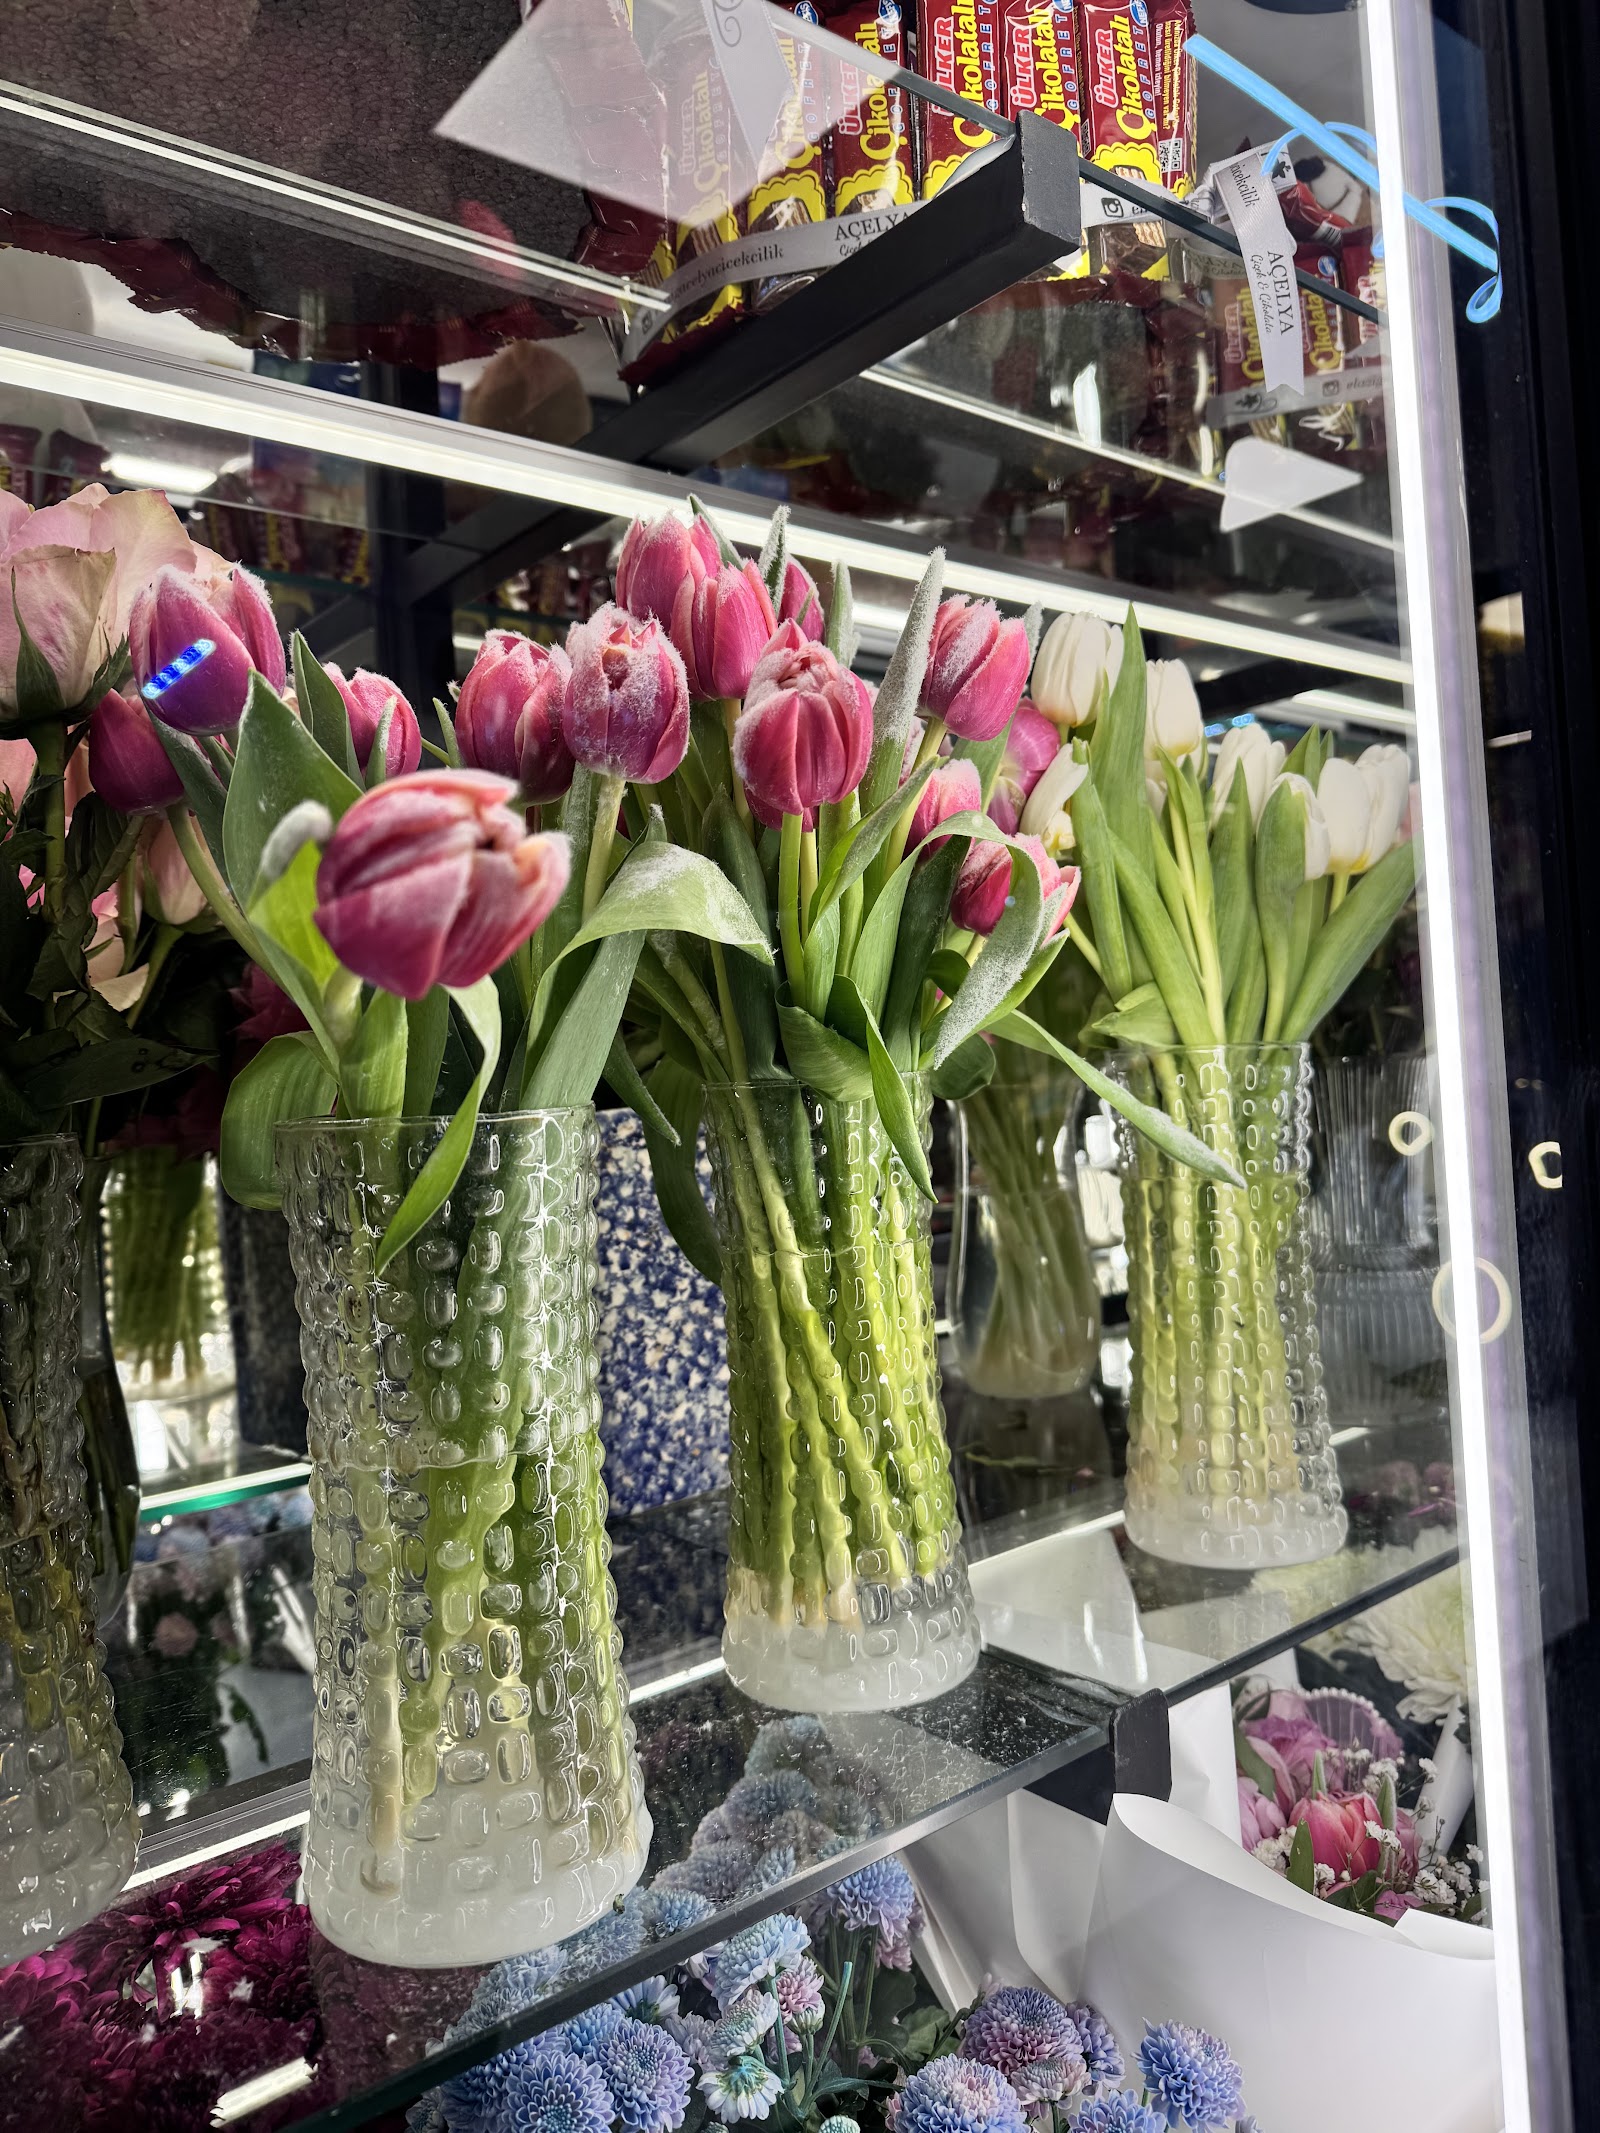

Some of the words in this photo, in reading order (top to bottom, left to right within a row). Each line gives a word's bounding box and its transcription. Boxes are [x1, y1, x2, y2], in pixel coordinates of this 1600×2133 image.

[881, 27, 906, 133] GOFET
[978, 4, 998, 111] GOFRET
[1010, 27, 1037, 108] ÜLKER
[1055, 13, 1080, 110] GOFRET
[1093, 29, 1118, 108] ÜLKER
[1110, 14, 1158, 140] Çikolatalı
[1133, 25, 1155, 119] GOFRET
[1155, 23, 1163, 48] Okutun,
[1155, 49, 1163, 72] hemen
[798, 42, 820, 142] GOFRET
[855, 22, 908, 160] Çikolaalı
[1162, 74, 1171, 105] bilmeyen
[1251, 254, 1266, 280] Çiçek
[1259, 294, 1276, 335] Çikolata
[1267, 251, 1295, 336] AÇELYA
